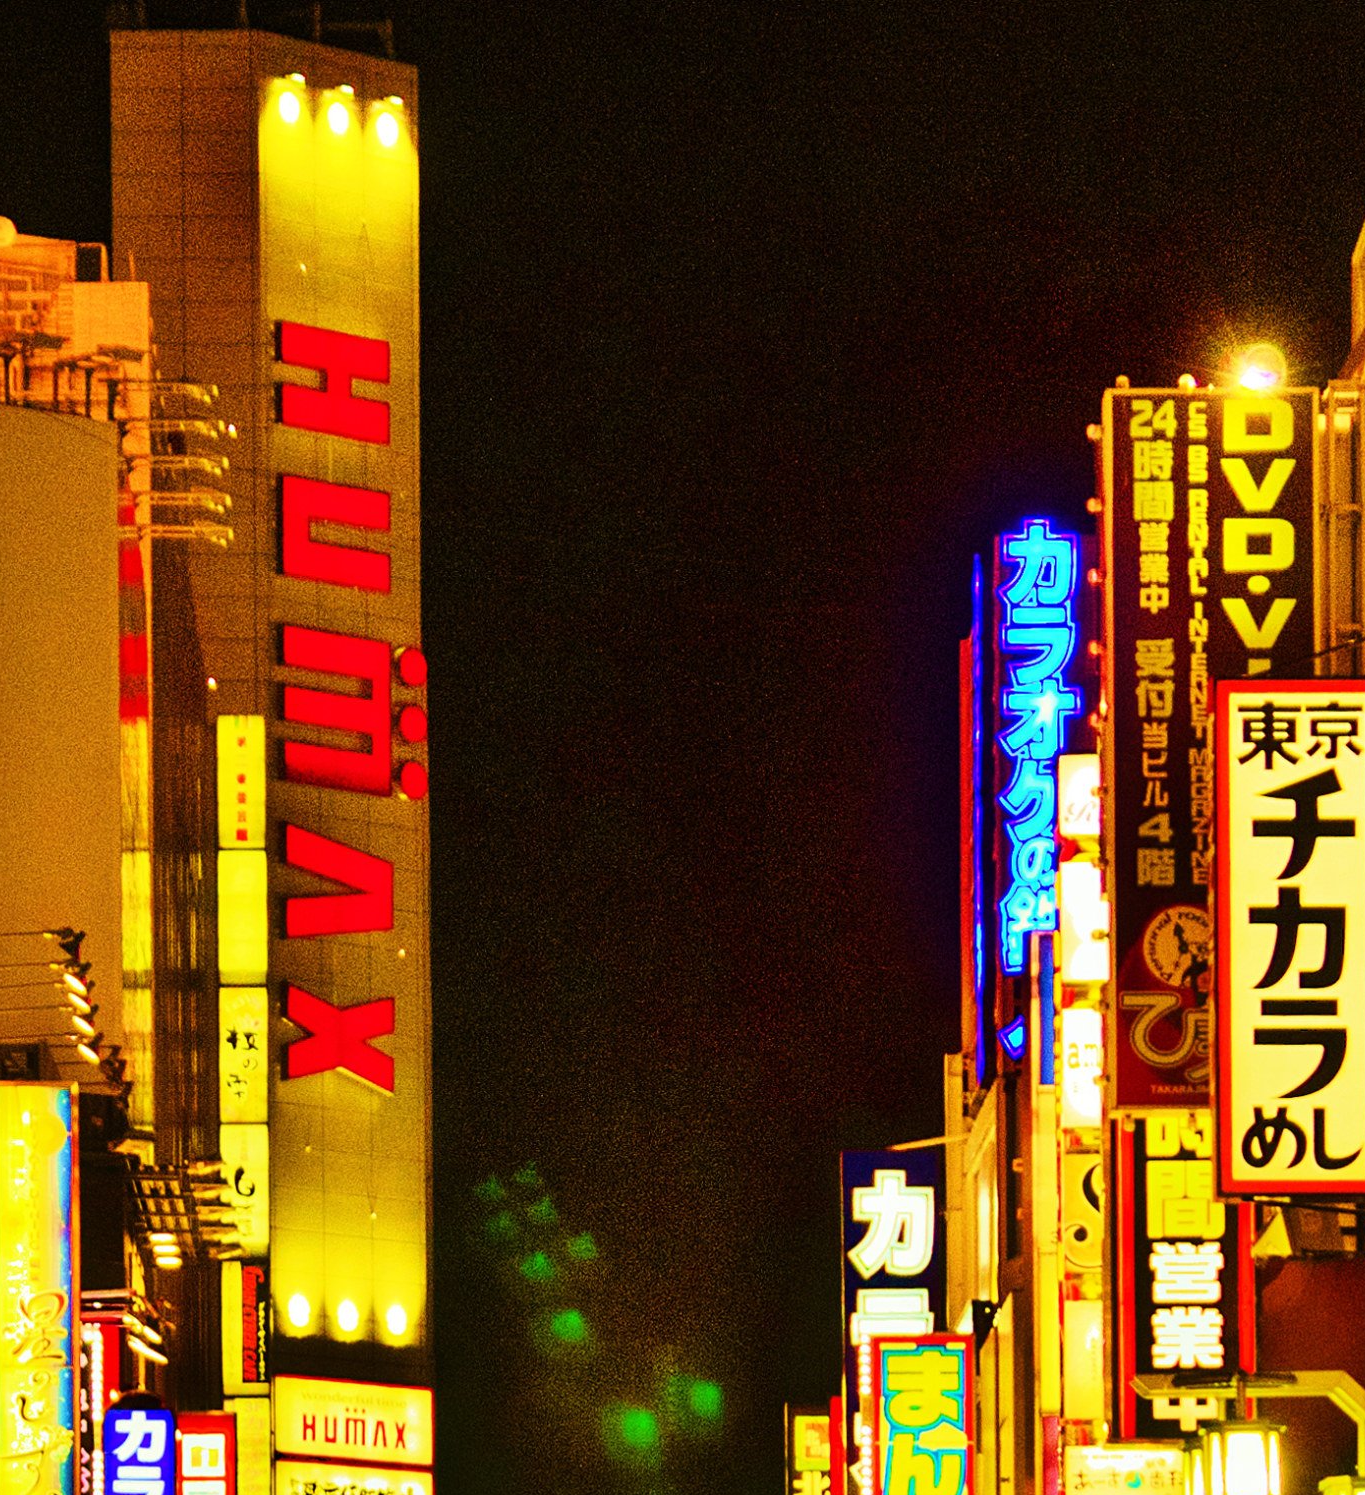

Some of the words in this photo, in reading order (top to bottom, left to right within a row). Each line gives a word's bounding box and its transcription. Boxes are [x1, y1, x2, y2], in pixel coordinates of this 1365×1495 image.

[280, 320, 427, 1095] HUMAX
[1238, 702, 1363, 769] 東京
[1241, 1105, 1363, 1170] めし
[302, 1408, 406, 1449] HUMAX
